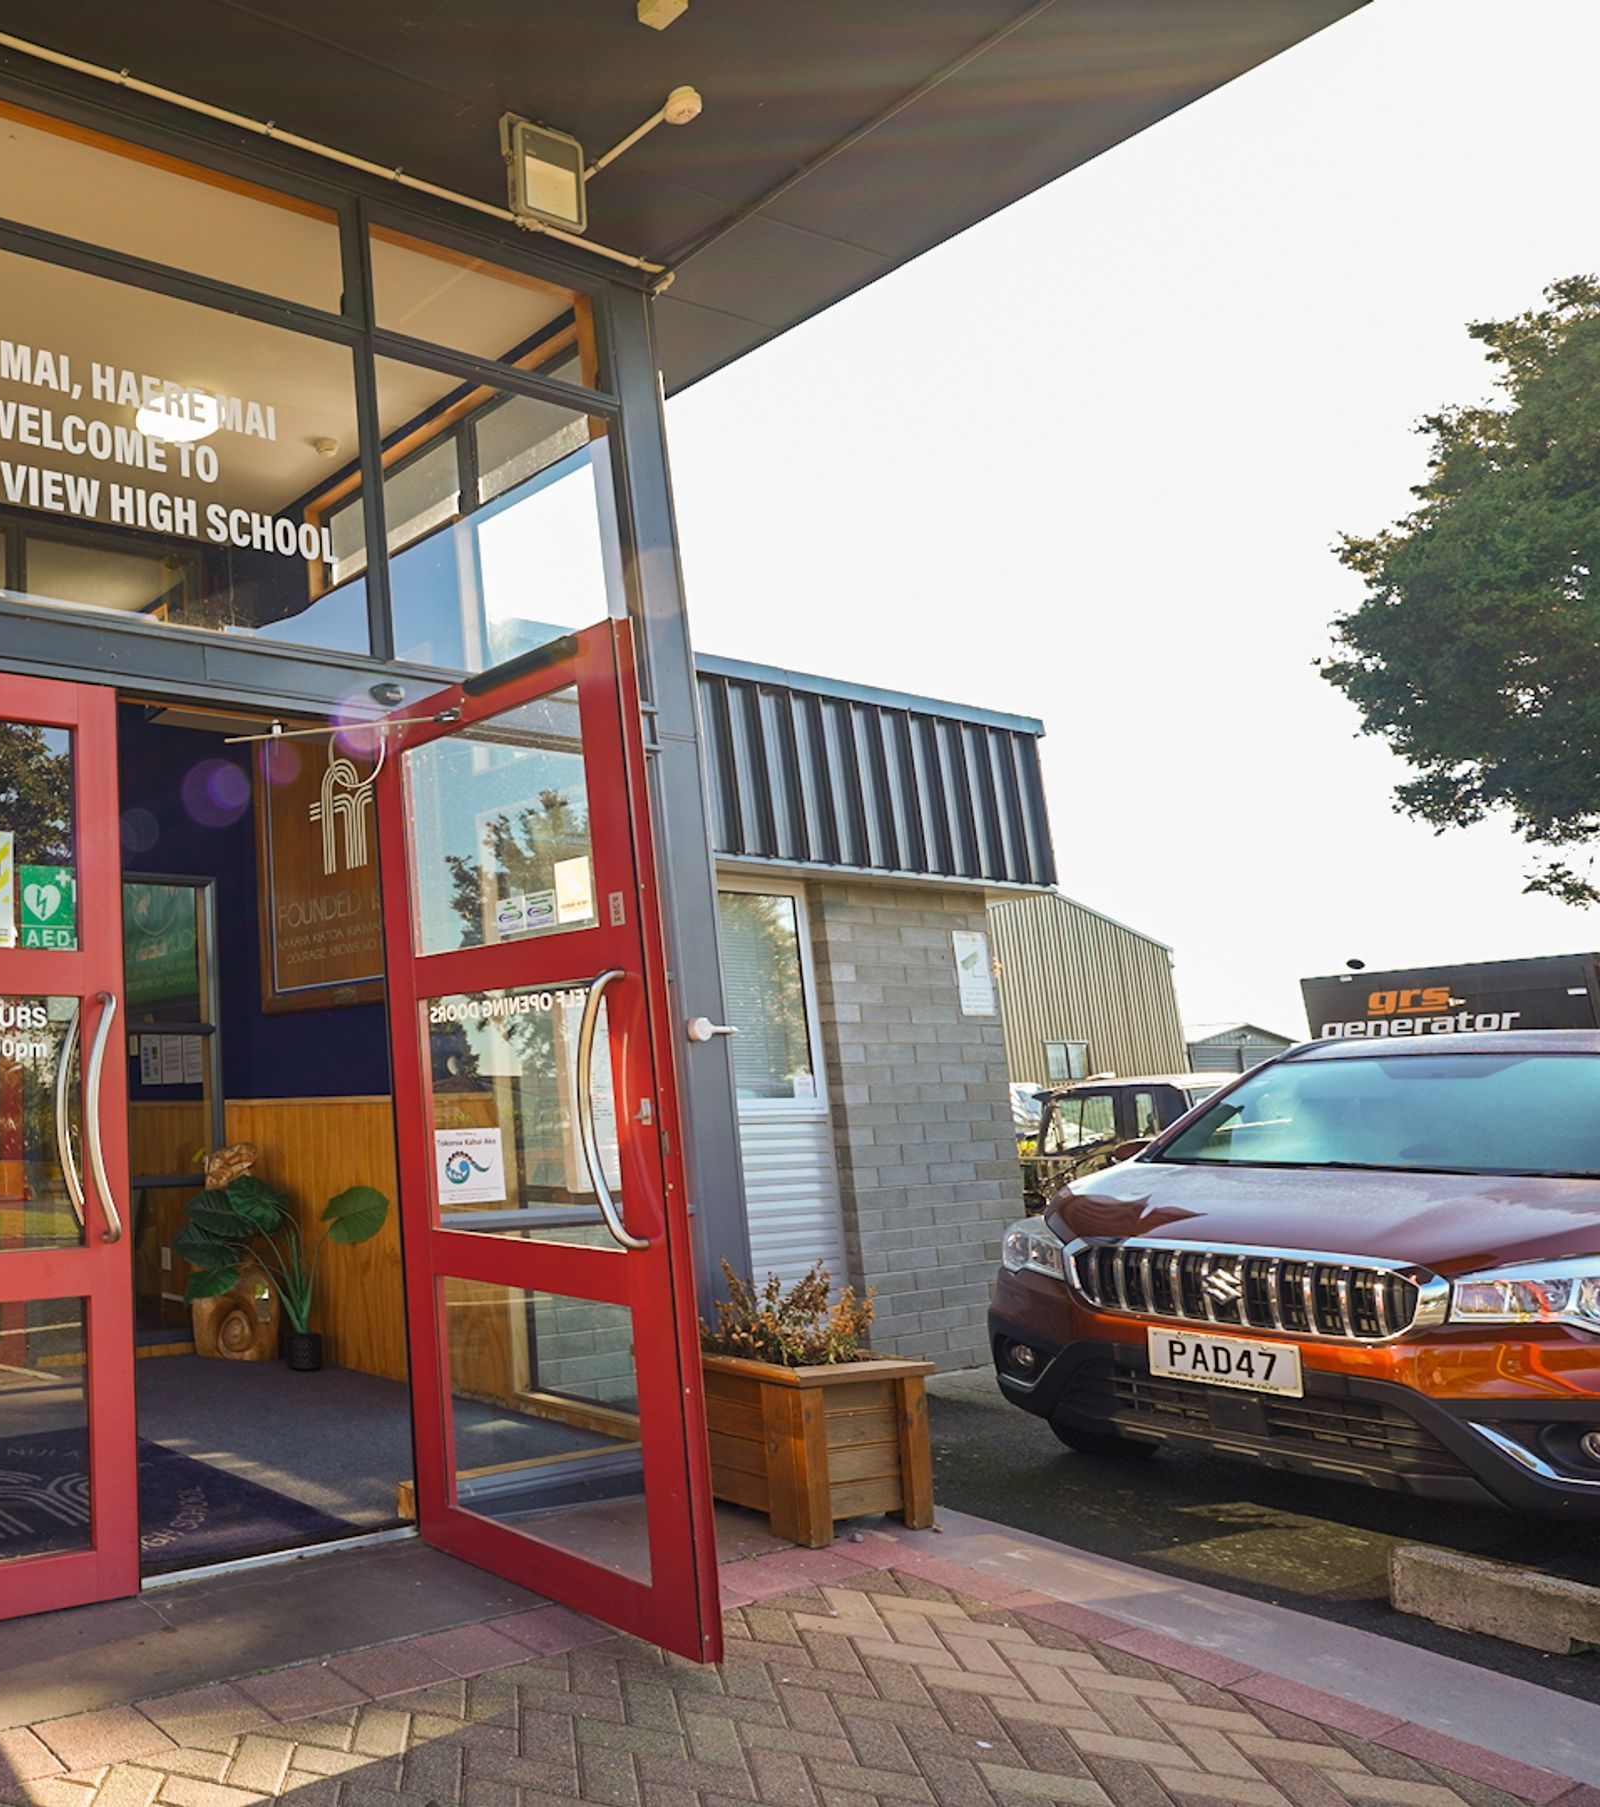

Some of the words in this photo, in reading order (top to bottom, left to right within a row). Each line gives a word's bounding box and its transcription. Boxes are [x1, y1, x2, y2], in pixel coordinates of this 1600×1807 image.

[0, 339, 82, 400] MAI,
[91, 362, 206, 424] HAERE
[216, 391, 277, 442] MAI
[175, 440, 219, 484] TO
[0, 461, 100, 517] VIEW
[110, 483, 198, 538] HIGH
[206, 503, 340, 566] SCHOOL
[277, 889, 362, 930] FOUNDED
[26, 928, 72, 947] AED
[1366, 985, 1451, 1016] grs
[1321, 1011, 1521, 1040] generator
[1168, 1339, 1278, 1381] PAD47
